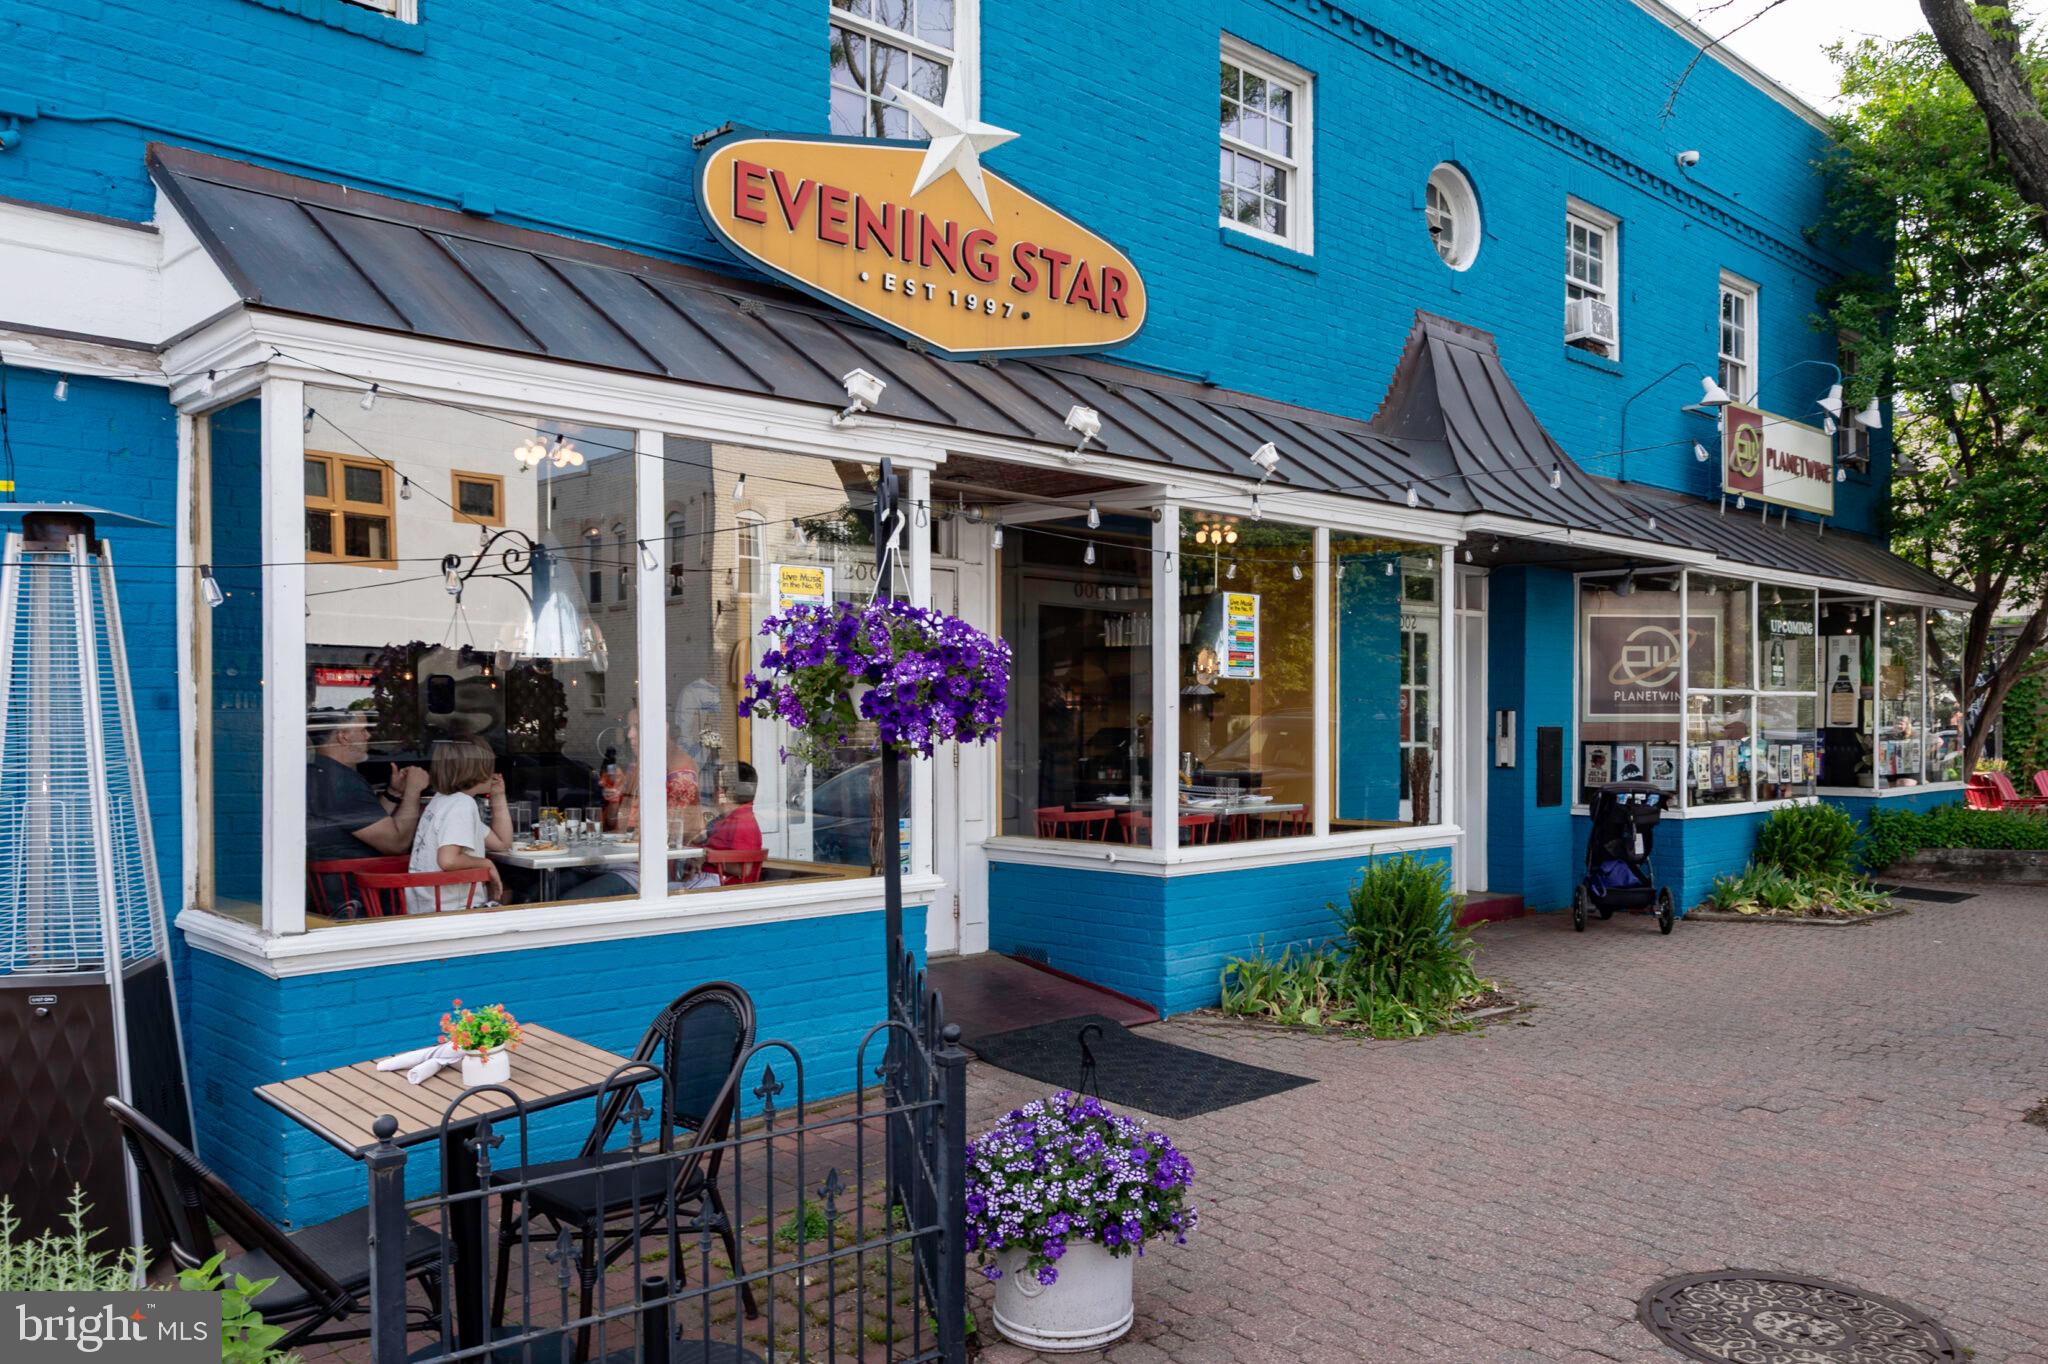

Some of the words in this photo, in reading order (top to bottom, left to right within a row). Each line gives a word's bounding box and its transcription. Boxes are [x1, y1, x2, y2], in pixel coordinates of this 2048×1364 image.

[732, 159, 999, 284] EVENING
[1011, 241, 1130, 320] STAR
[882, 272, 936, 301] EST
[948, 289, 1015, 319] 1997
[1766, 447, 1833, 484] PLANETWINE
[782, 572, 798, 581] Live
[800, 573, 822, 583] Music
[1770, 619, 1813, 635] UPCOMING
[1614, 690, 1681, 702] PLANETWIN
